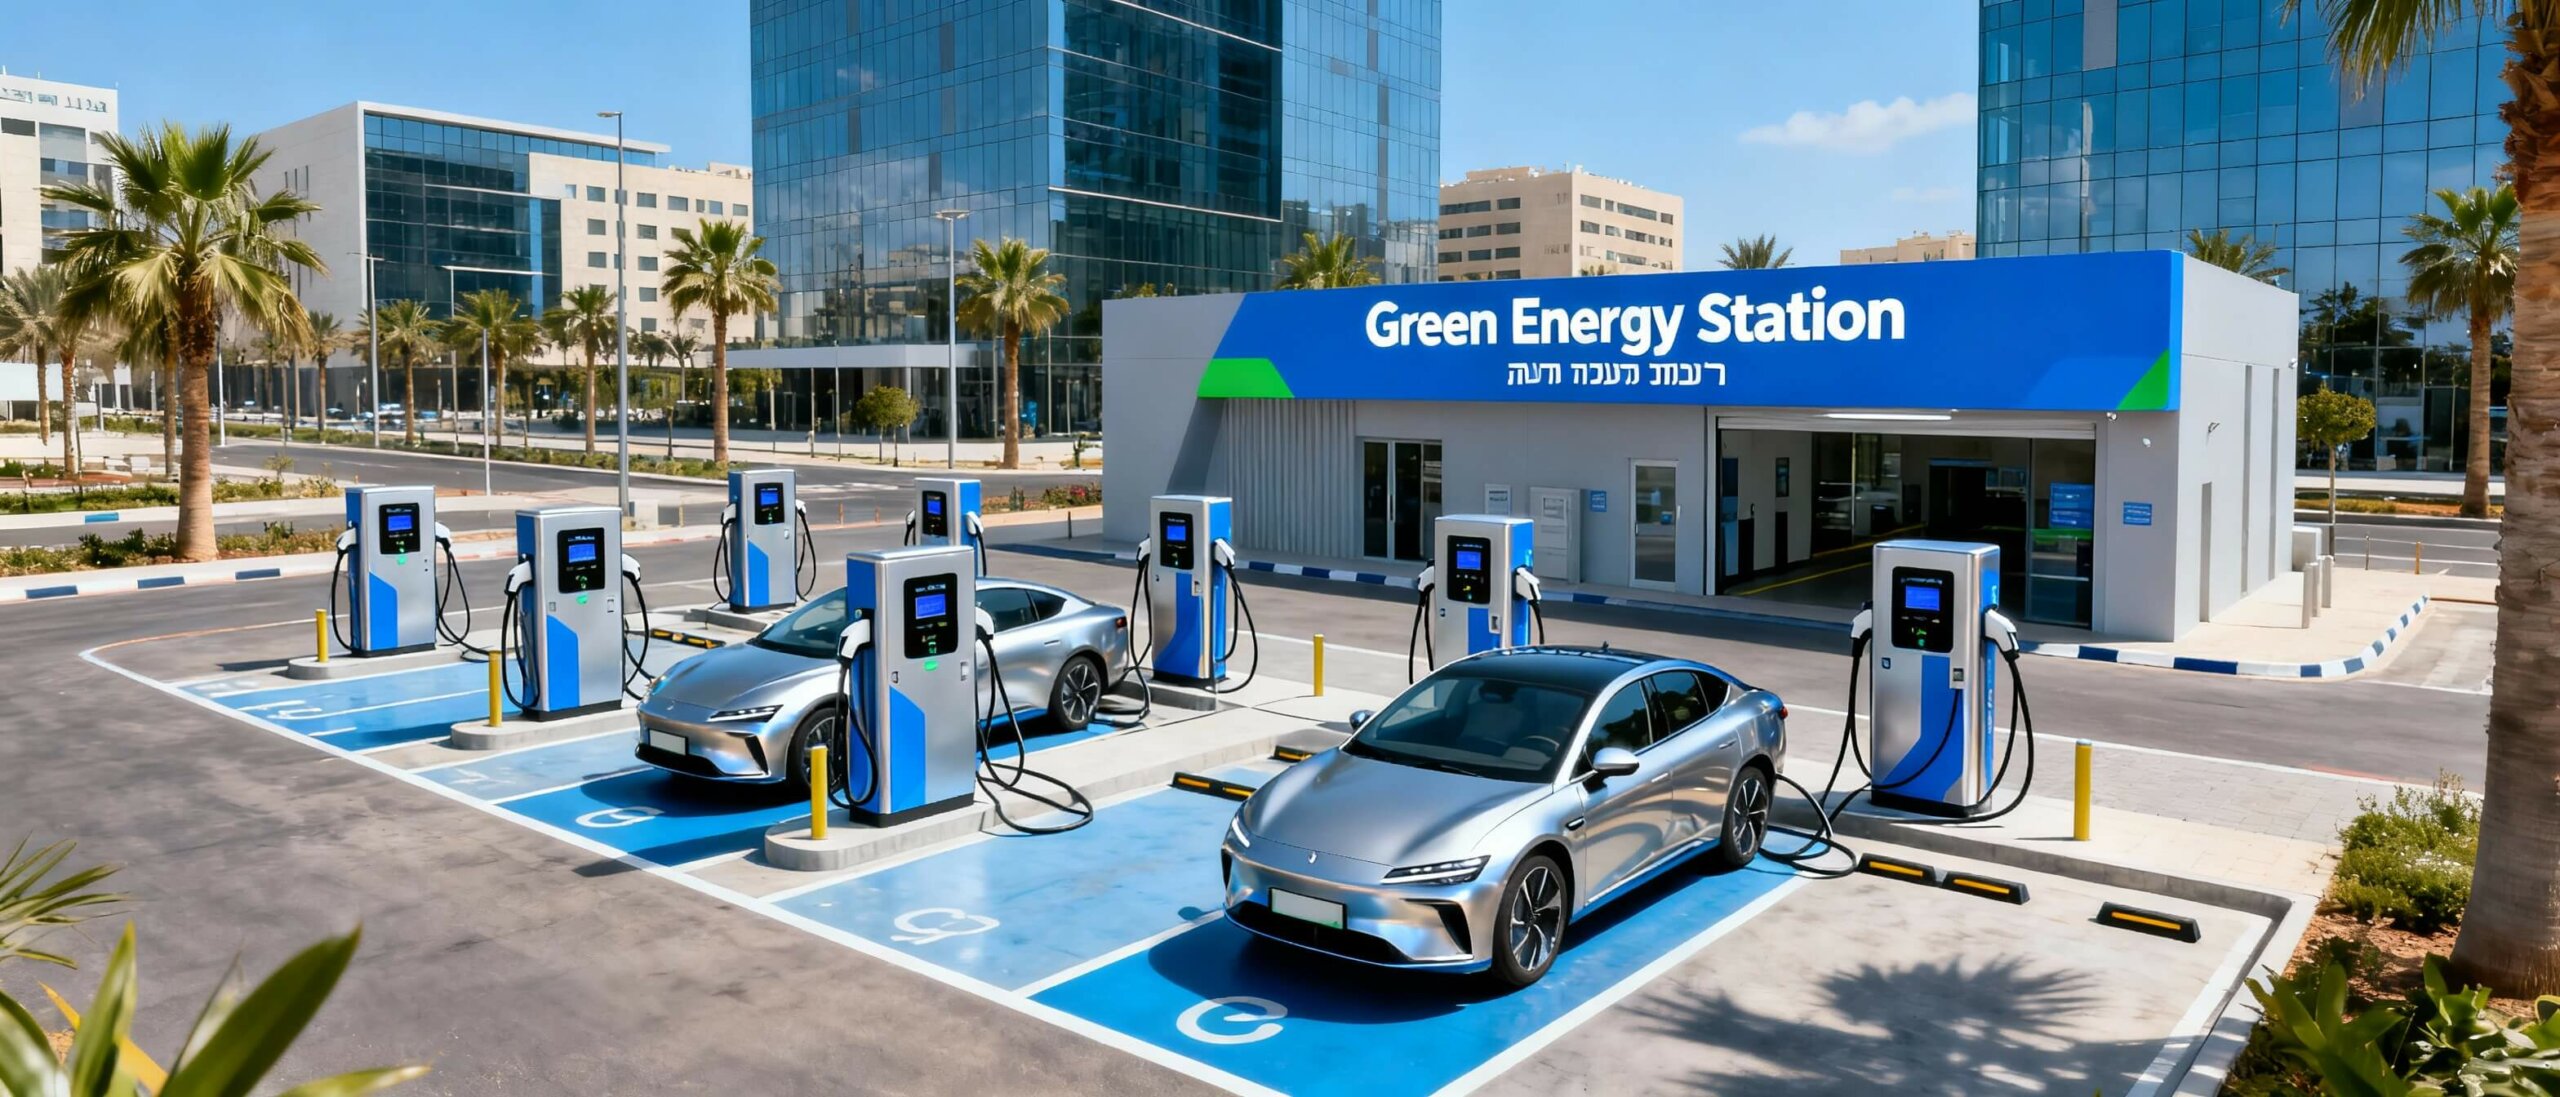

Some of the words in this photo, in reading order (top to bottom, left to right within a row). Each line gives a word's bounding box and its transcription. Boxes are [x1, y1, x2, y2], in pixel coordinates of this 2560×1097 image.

[1365, 300, 1498, 348] Green
[1512, 297, 1685, 357] Energy
[1697, 285, 1905, 343] Station
